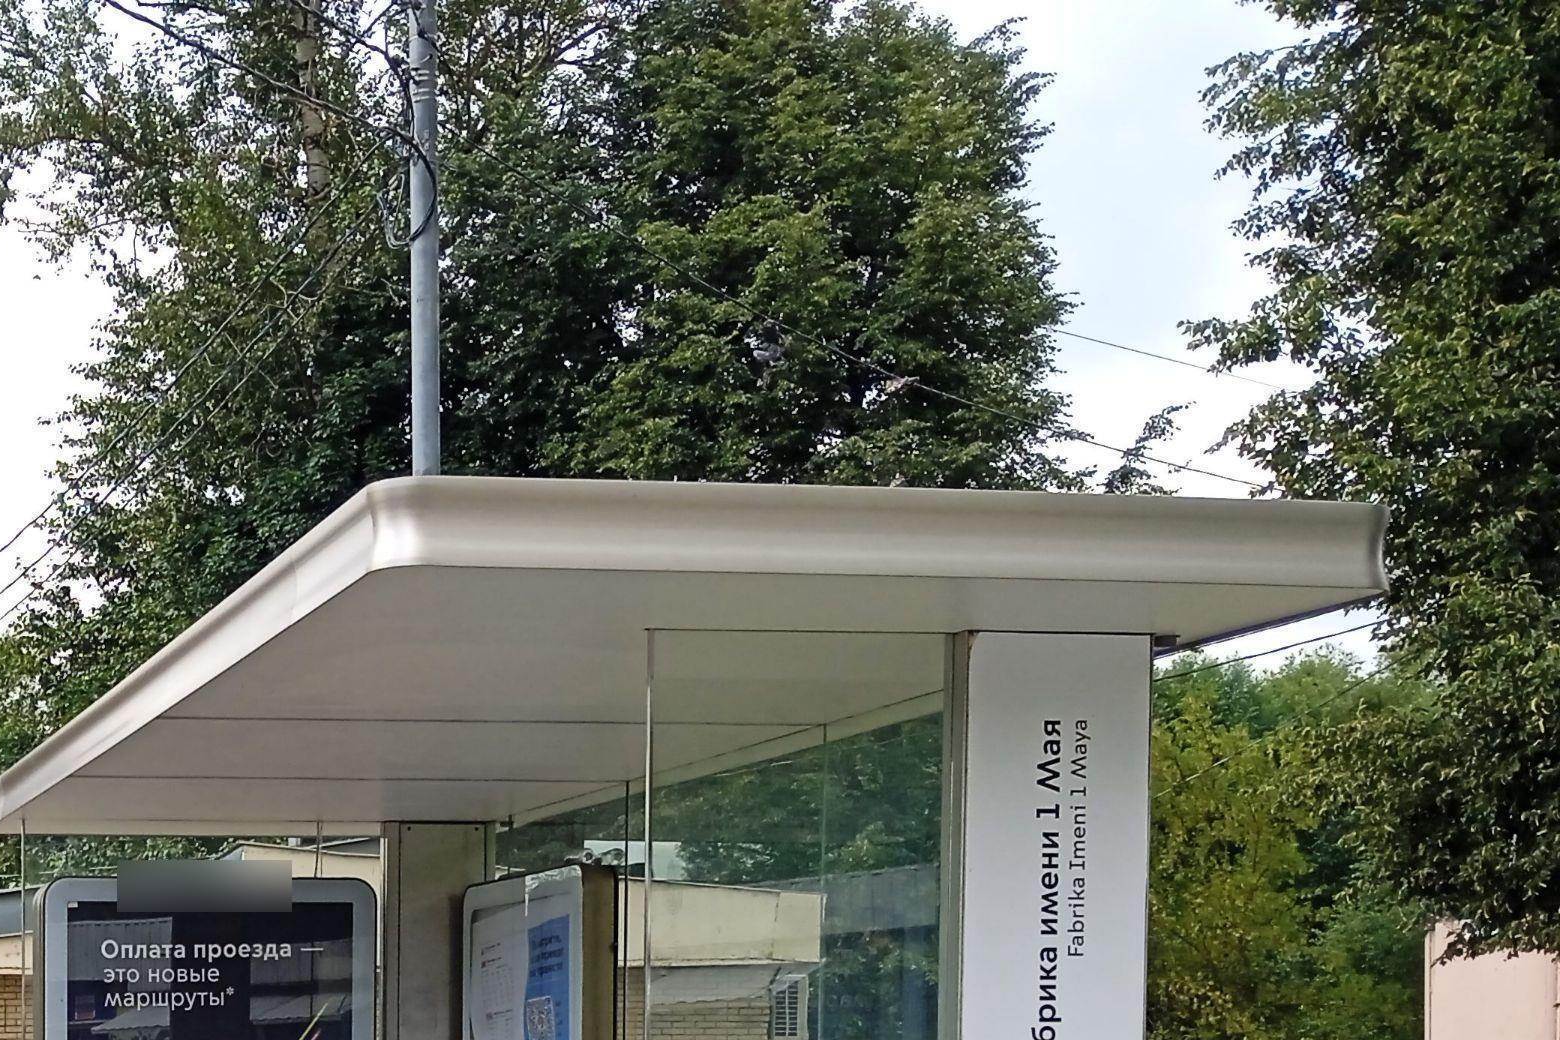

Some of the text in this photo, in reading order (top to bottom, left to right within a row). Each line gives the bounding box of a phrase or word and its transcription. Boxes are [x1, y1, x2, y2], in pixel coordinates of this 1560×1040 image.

[1036, 719, 1061, 793] Мая
[1036, 803, 1060, 819] 1
[1067, 719, 1092, 957] Fabrika Imeni 1 Maya
[1040, 832, 1060, 936] имени
[100, 939, 186, 960] Оплата
[193, 942, 292, 963] проезда
[103, 967, 221, 984] это новые
